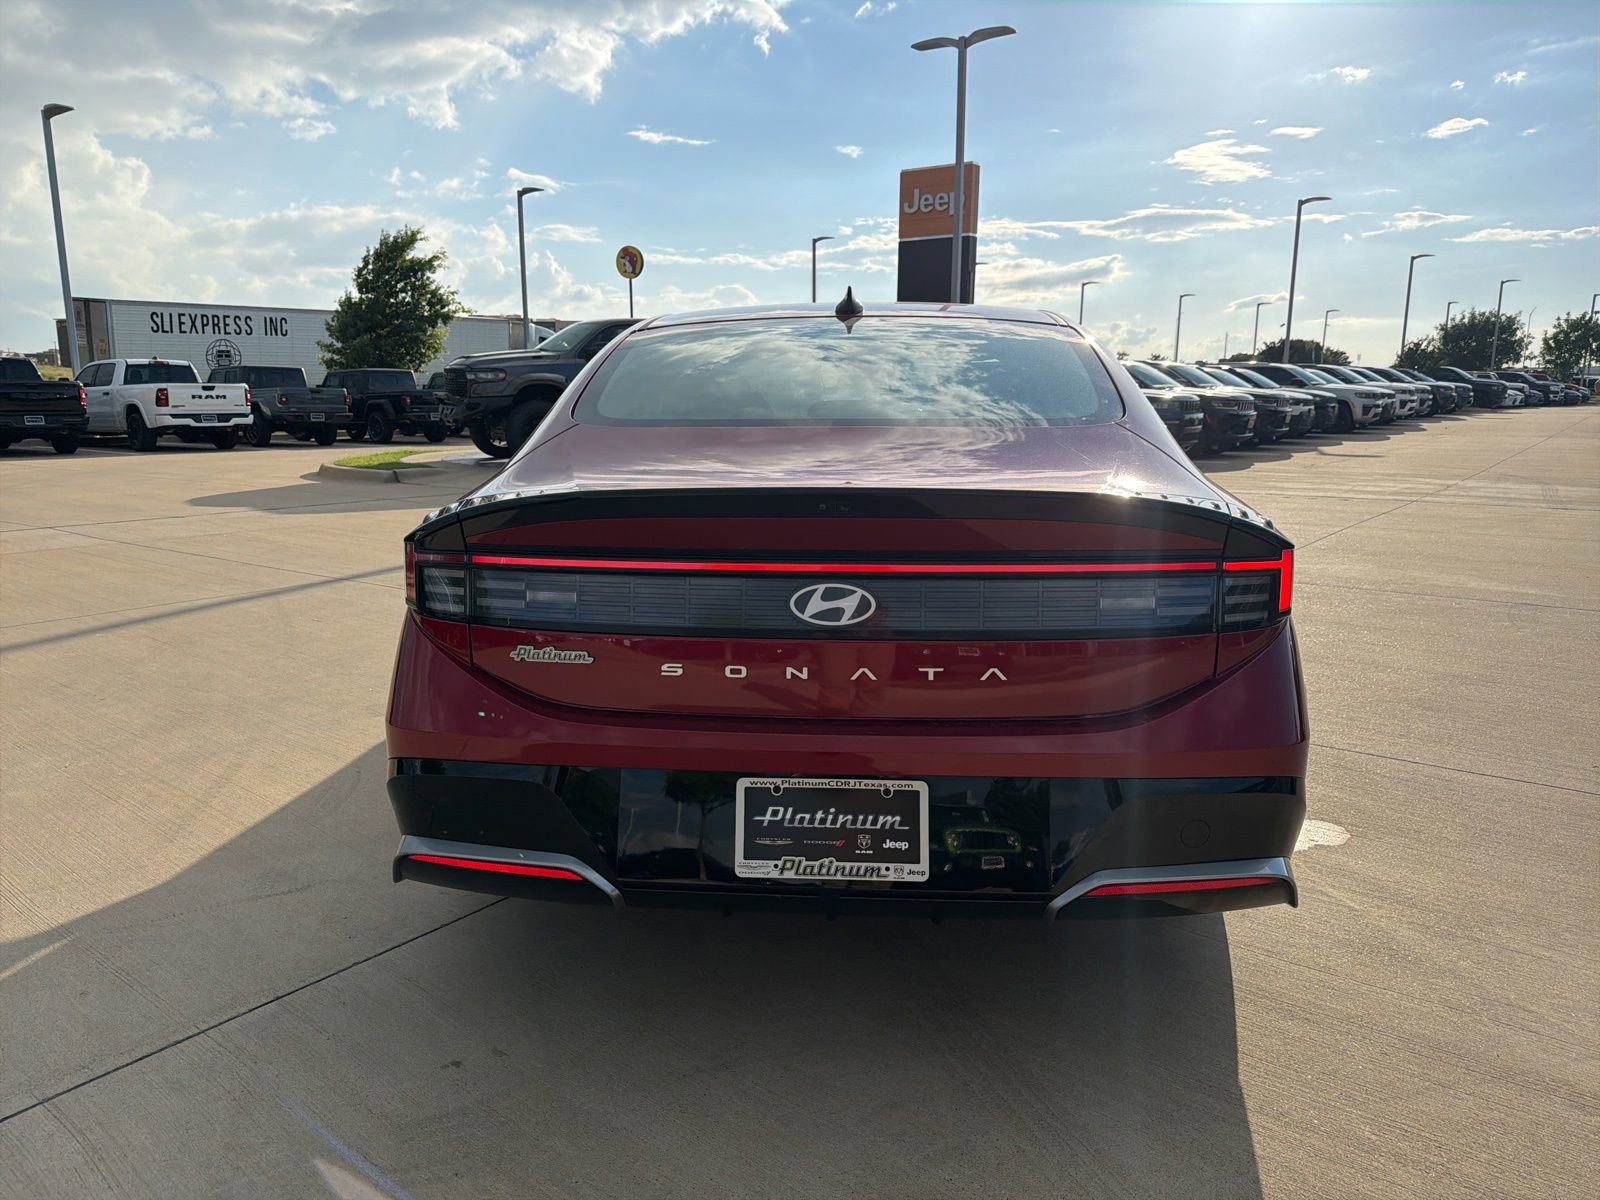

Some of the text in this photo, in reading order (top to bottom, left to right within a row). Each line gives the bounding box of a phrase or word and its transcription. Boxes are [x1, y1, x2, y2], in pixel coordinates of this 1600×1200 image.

[150, 311, 289, 337] SLI EXPRESS INC
[509, 645, 594, 664] Platinum
[660, 662, 1008, 682] SONATA
[749, 779, 914, 789] www.PlatinumCDRJTexas.com
[752, 806, 910, 830] Platinum
[882, 839, 909, 851] Jeep
[776, 857, 890, 878] Platinum
[907, 868, 926, 876] Jeep
